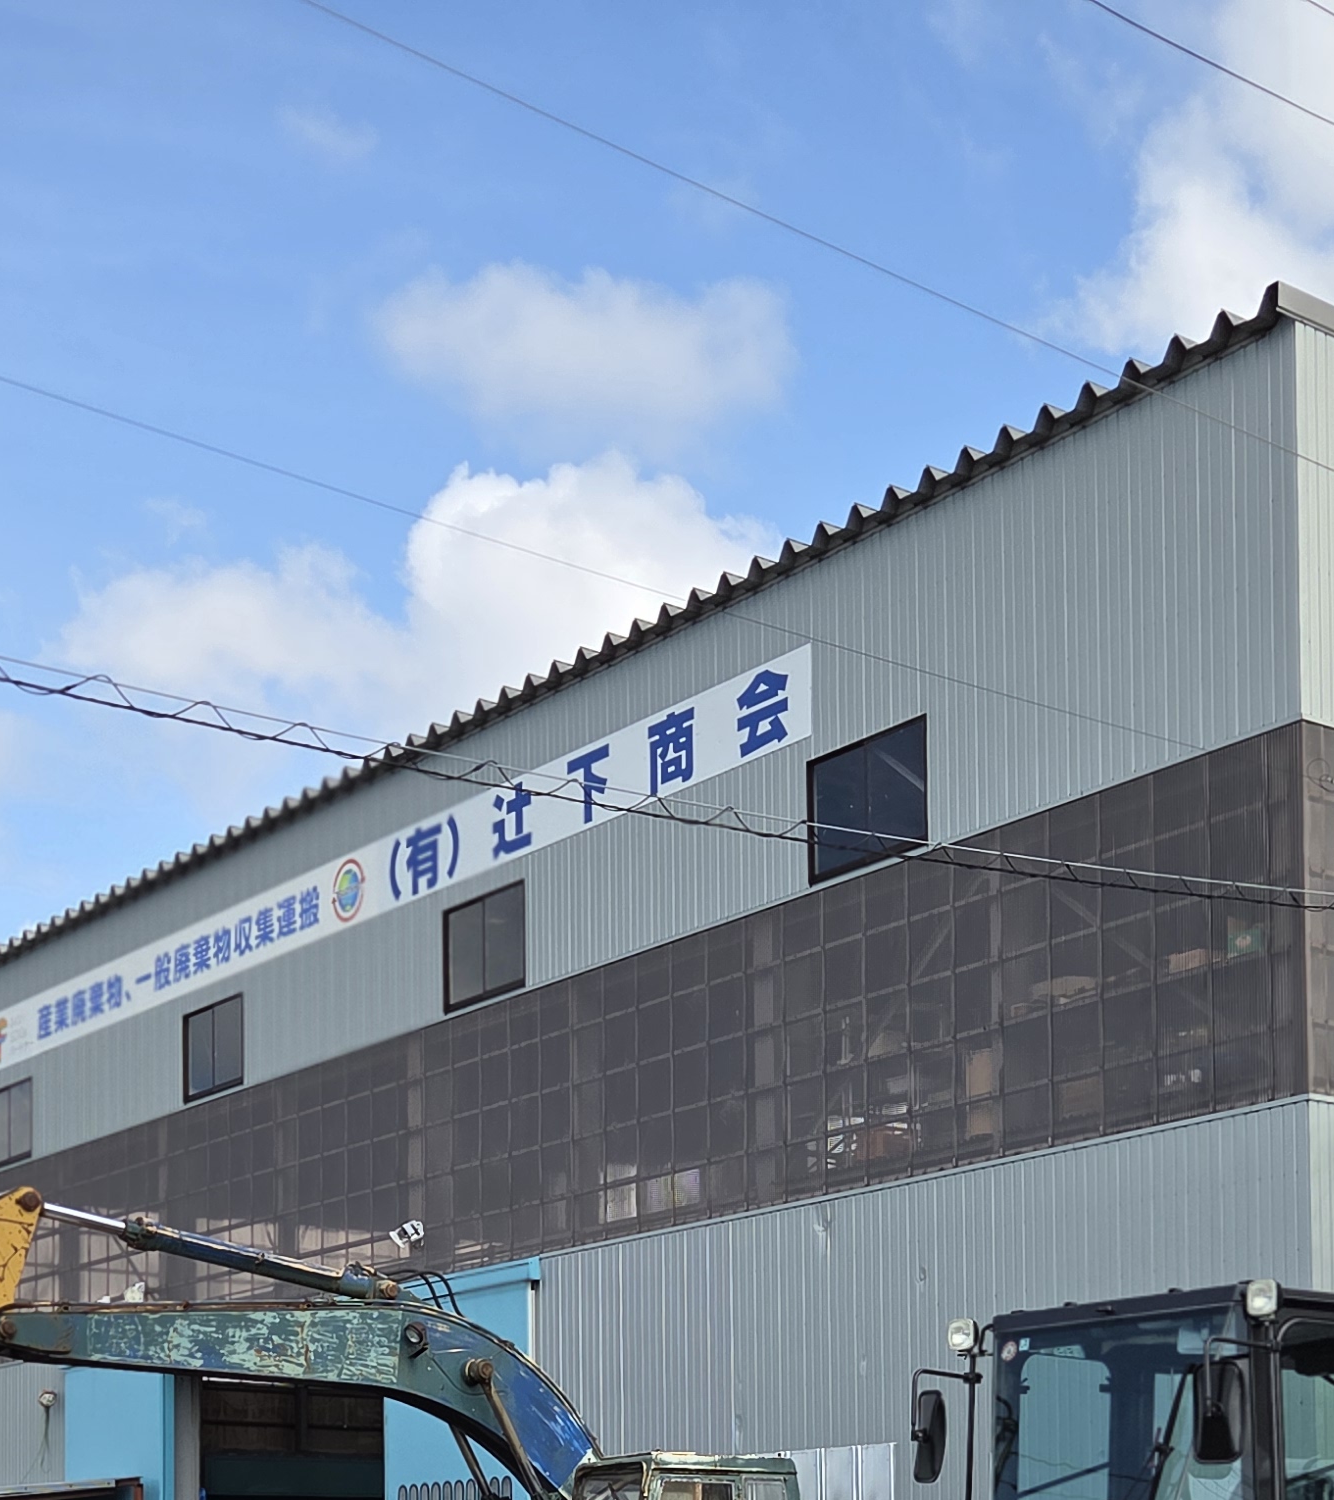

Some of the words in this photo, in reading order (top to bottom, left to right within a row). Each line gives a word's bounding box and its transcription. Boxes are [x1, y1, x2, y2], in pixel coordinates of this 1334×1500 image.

[36, 886, 321, 1041] 産業廃棄物、一般廃棄物収集運搬
